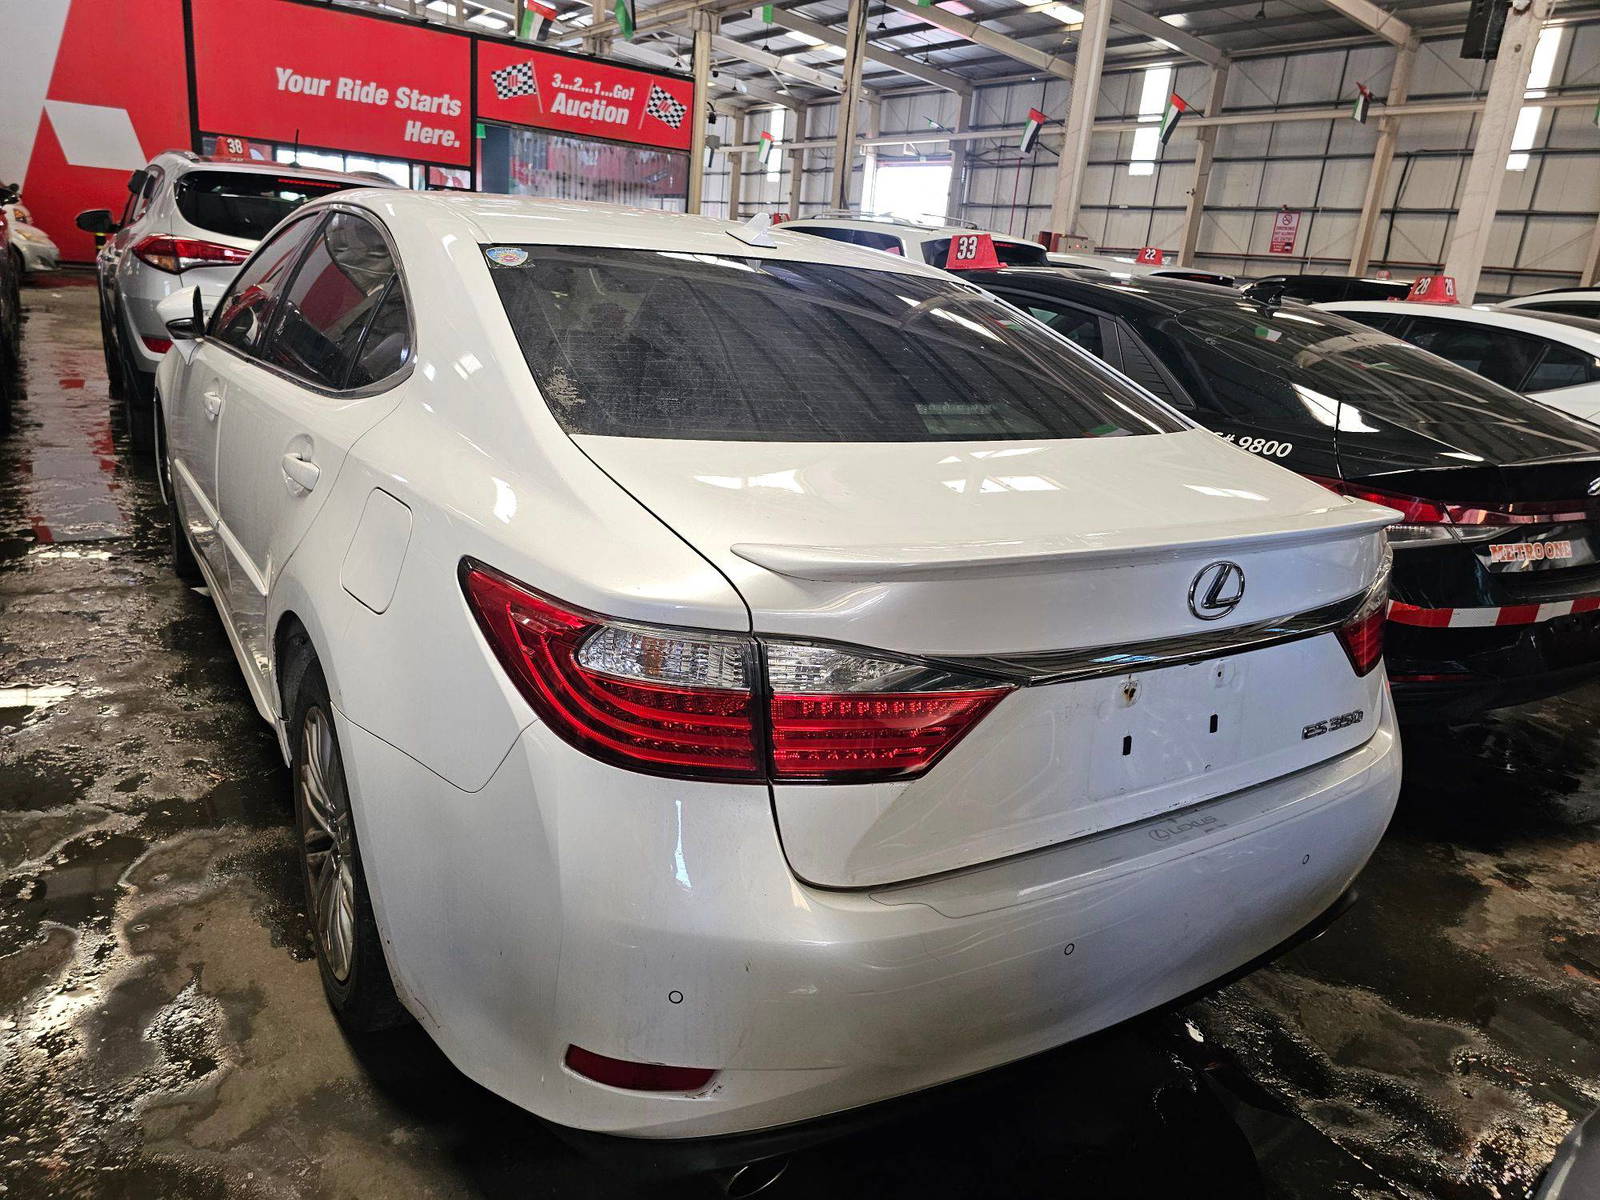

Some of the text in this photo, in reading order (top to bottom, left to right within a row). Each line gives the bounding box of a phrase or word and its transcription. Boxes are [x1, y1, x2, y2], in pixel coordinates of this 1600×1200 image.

[275, 67, 462, 117] Your Ride Starts
[550, 92, 629, 125] Auction
[226, 138, 243, 154] 38
[404, 120, 461, 148] Here.
[957, 236, 978, 260] 33
[1144, 248, 1156, 260] 22
[1238, 436, 1293, 458] 9800
[1301, 710, 1364, 740] ES 350
